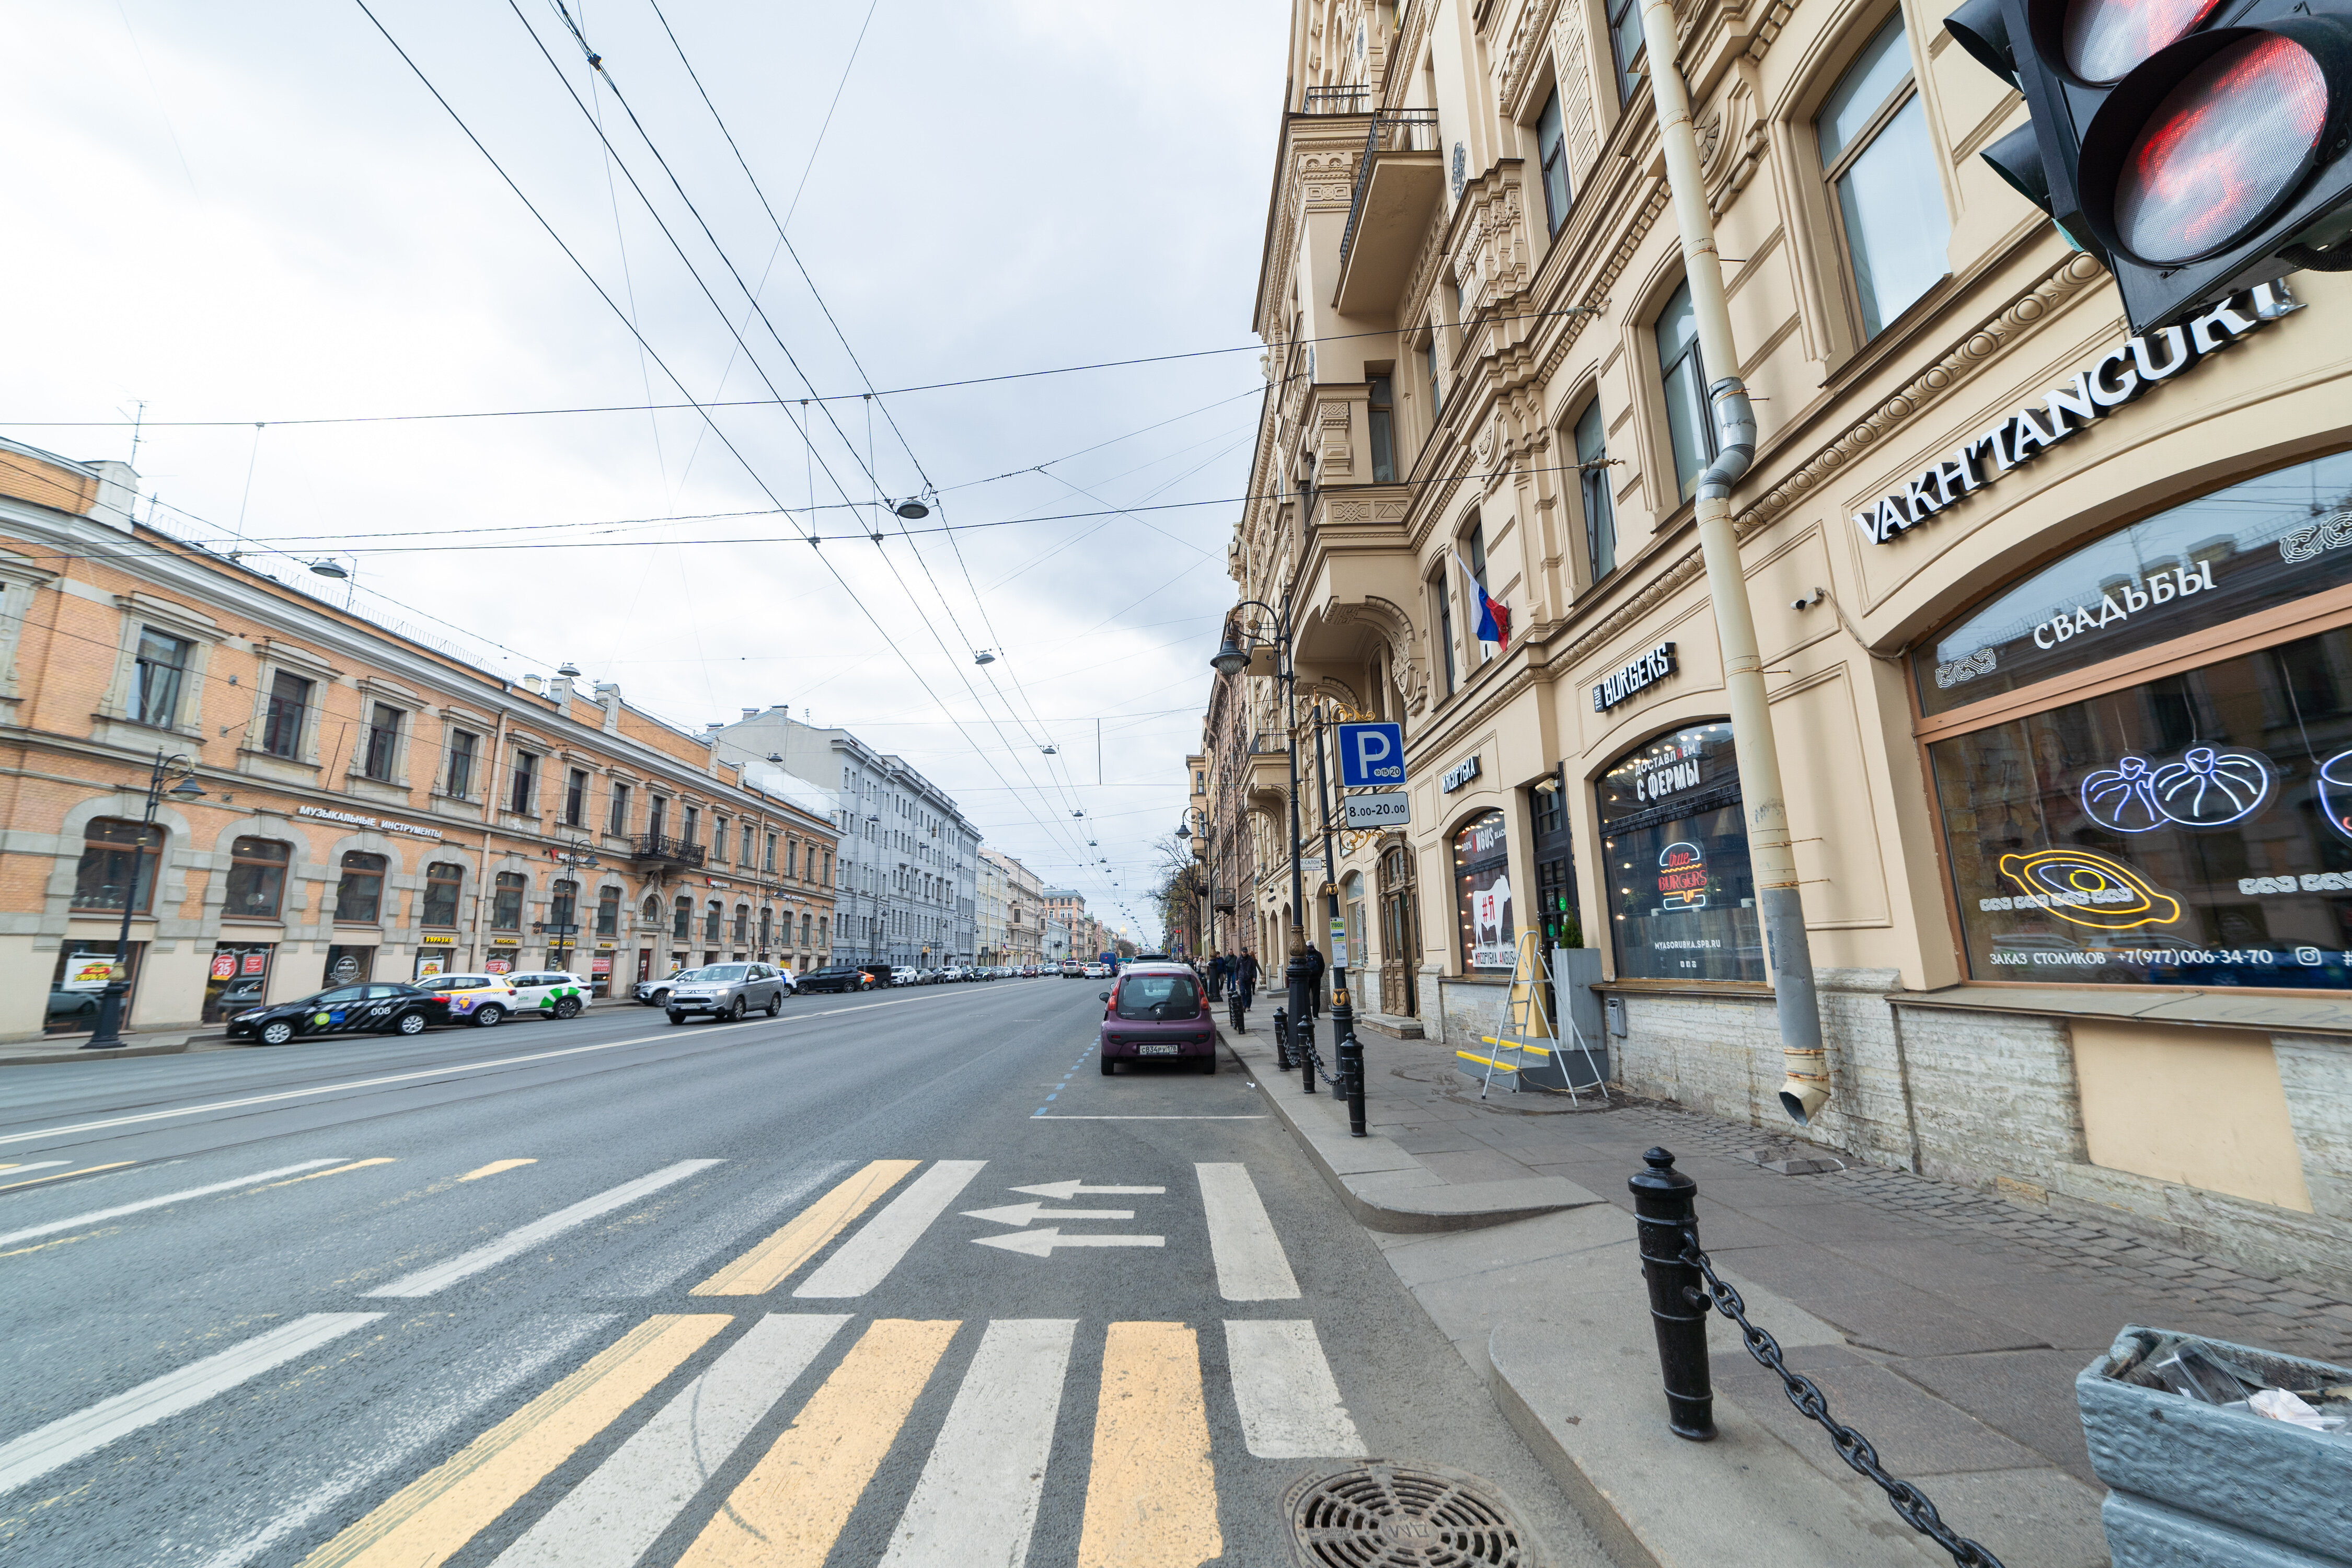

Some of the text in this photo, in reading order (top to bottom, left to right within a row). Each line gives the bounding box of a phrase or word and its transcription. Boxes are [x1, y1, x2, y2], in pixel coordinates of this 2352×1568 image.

[2033, 560, 2218, 650] СВАДЬБЫ
[1593, 643, 1670, 710] TRUE BURGERS
[1635, 743, 1696, 777] ДОСТАВЛЯЕМ
[1442, 756, 1475, 794] МЯСОРУБКА
[1636, 759, 1700, 801] С ФЕРМЫ
[1349, 804, 1405, 817] 8.00-20.00
[299, 805, 442, 838] МУЗЫКАЛЬНЫЕ ИНСТРУМЕНТЫ
[1668, 851, 1690, 867] true
[1658, 870, 1707, 891] BURGERS
[1654, 939, 1721, 949] MYASORUBKA.SPB.RU
[1475, 951, 1497, 964] МЯСОРУБКА
[1990, 953, 2027, 965] ЗАКАЗ
[2033, 952, 2106, 965] СТОЛИКОВ
[2117, 948, 2273, 966] +7(977)006-34-70
[216, 963, 231, 975] 35
[499, 962, 508, 971] 70
[371, 1007, 391, 1016] 008
